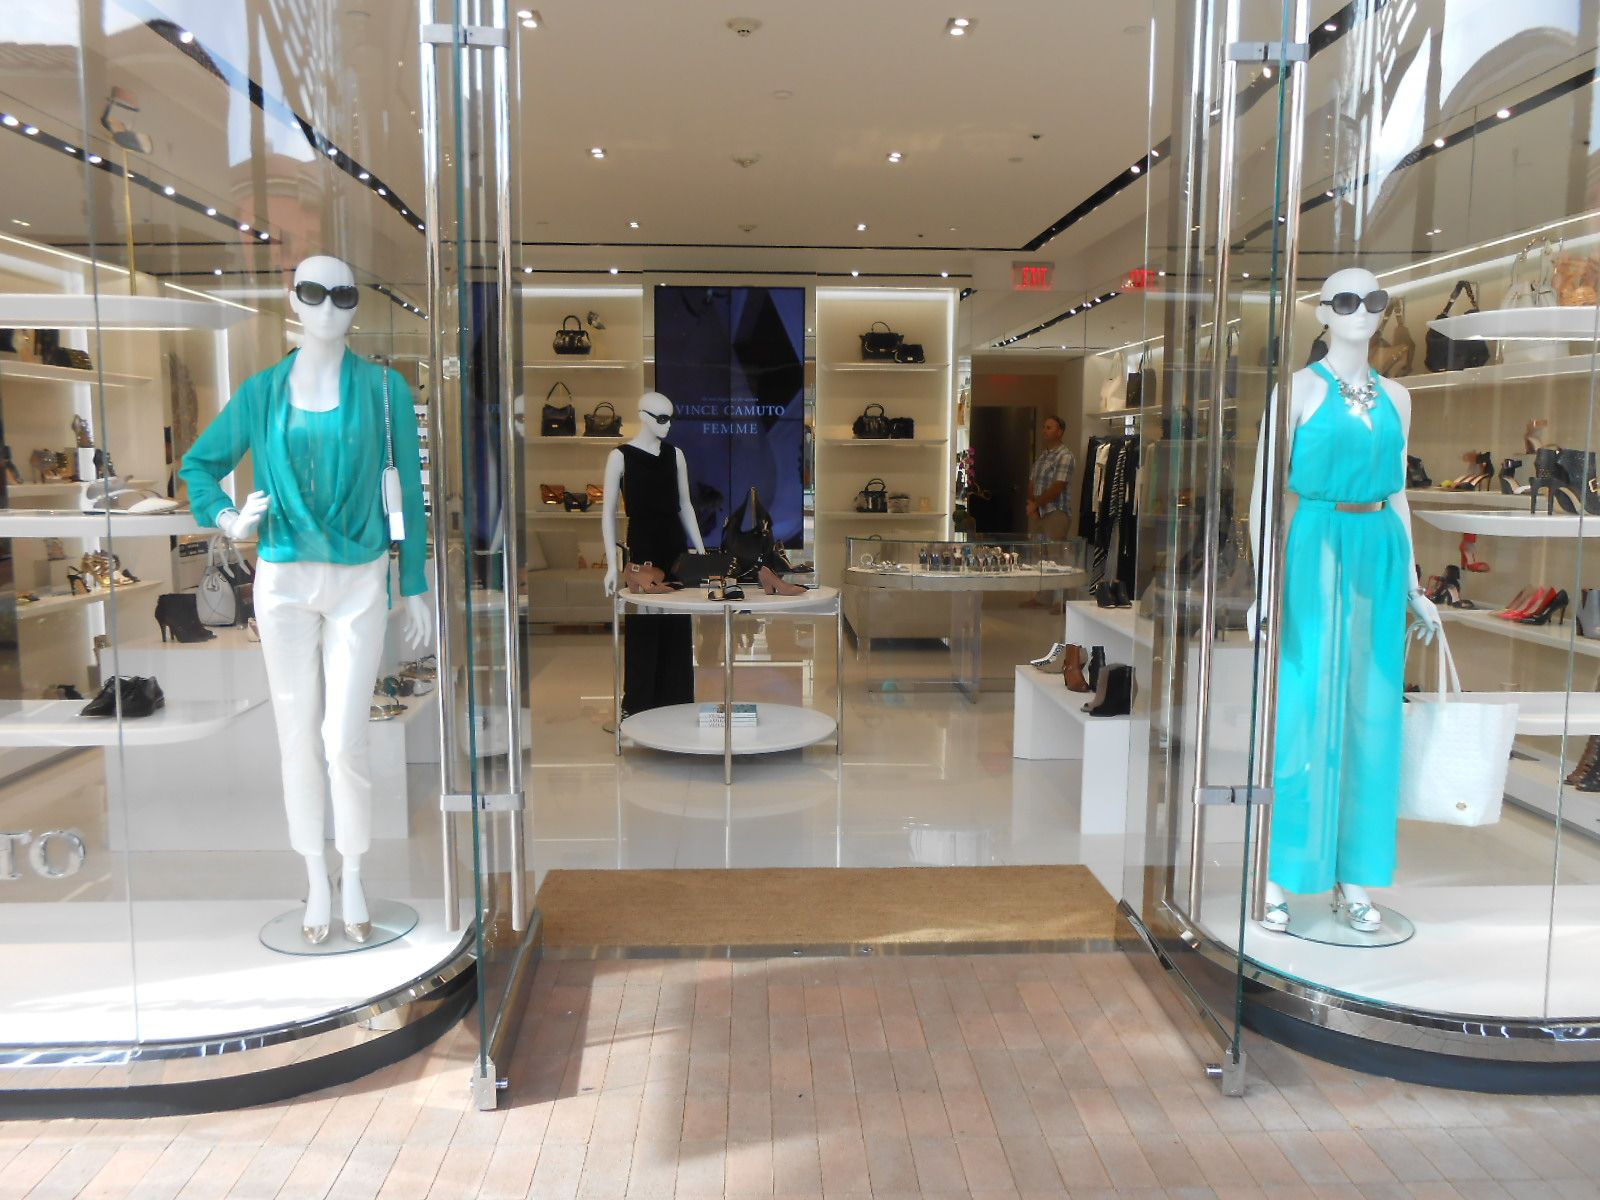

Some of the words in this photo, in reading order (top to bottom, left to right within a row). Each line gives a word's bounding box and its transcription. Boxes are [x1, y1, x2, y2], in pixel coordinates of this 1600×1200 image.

[1023, 266, 1048, 288] EXIT
[675, 404, 719, 416] VINCE
[723, 404, 786, 416] CAMUTO
[702, 422, 759, 435] FEMME
